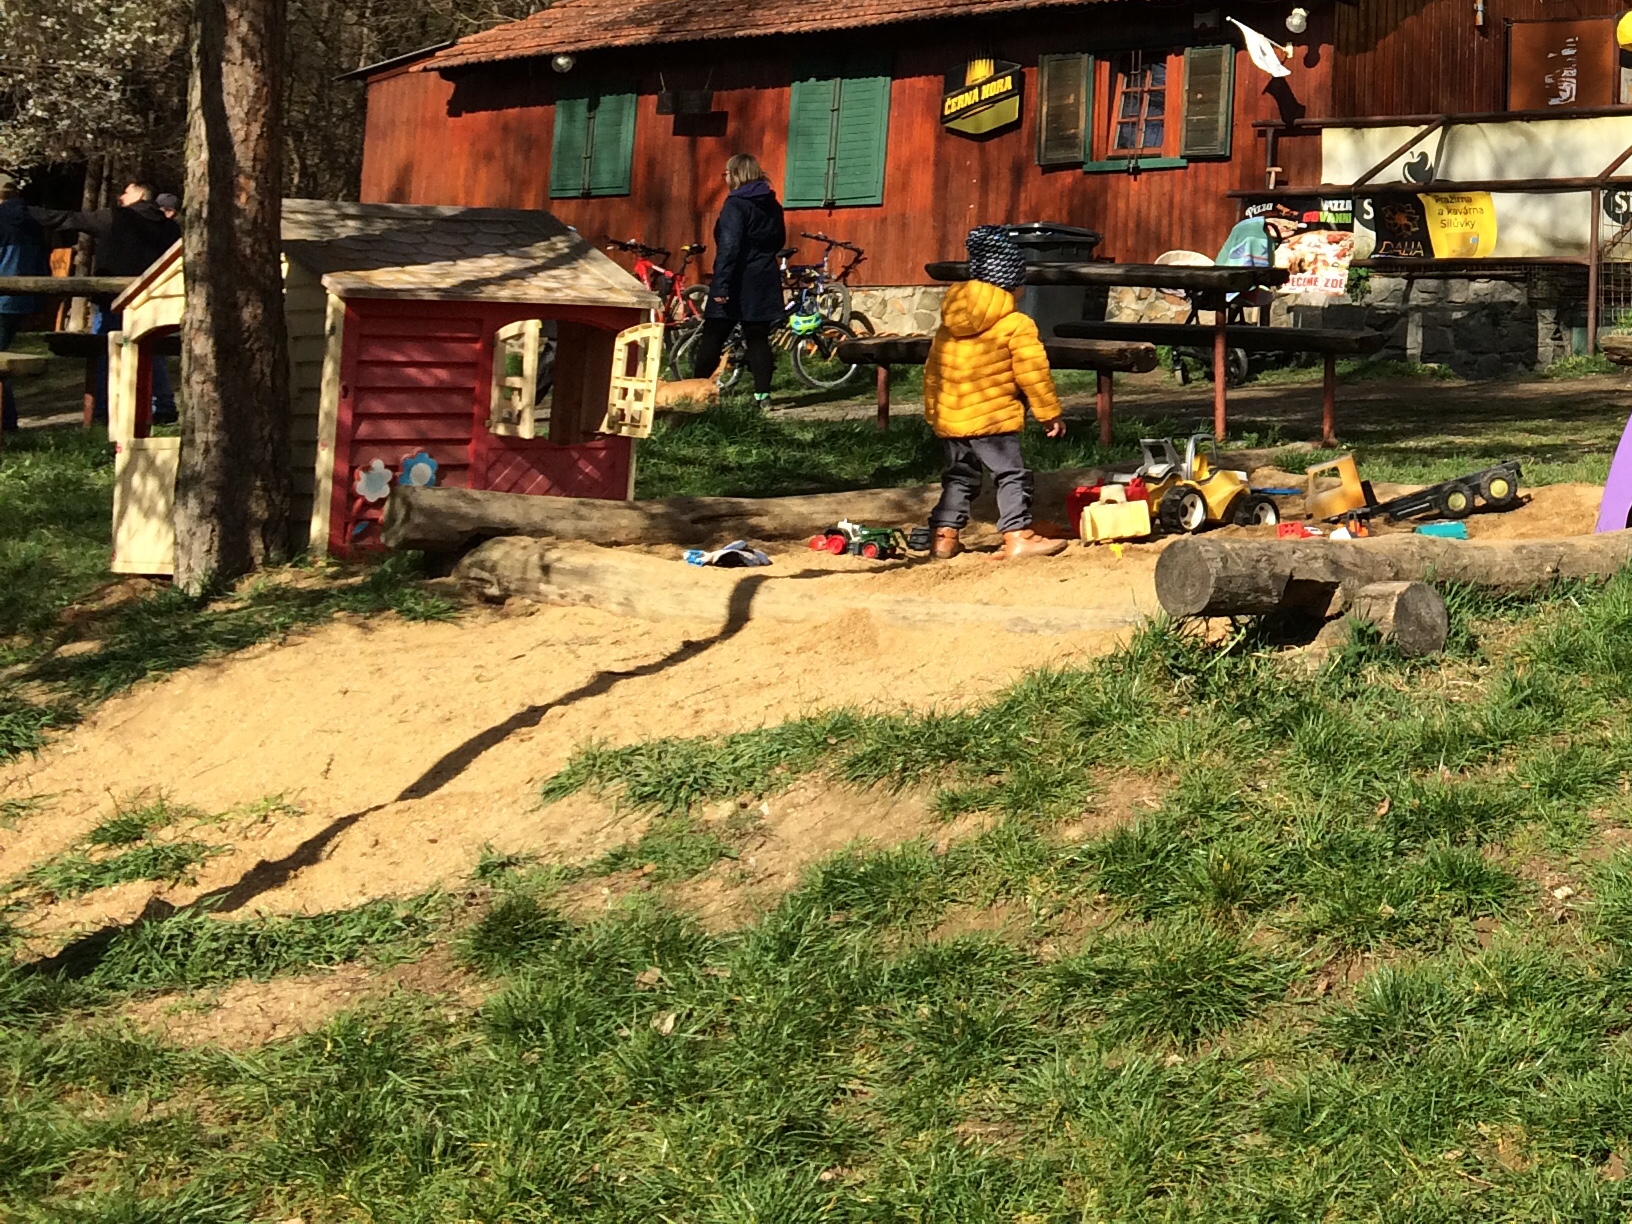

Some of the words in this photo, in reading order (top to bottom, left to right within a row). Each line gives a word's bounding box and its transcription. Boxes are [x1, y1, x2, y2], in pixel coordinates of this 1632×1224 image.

[944, 86, 979, 115] ČERNÁ
[981, 76, 1012, 100] HORA
[1324, 277, 1344, 288] ZDE
